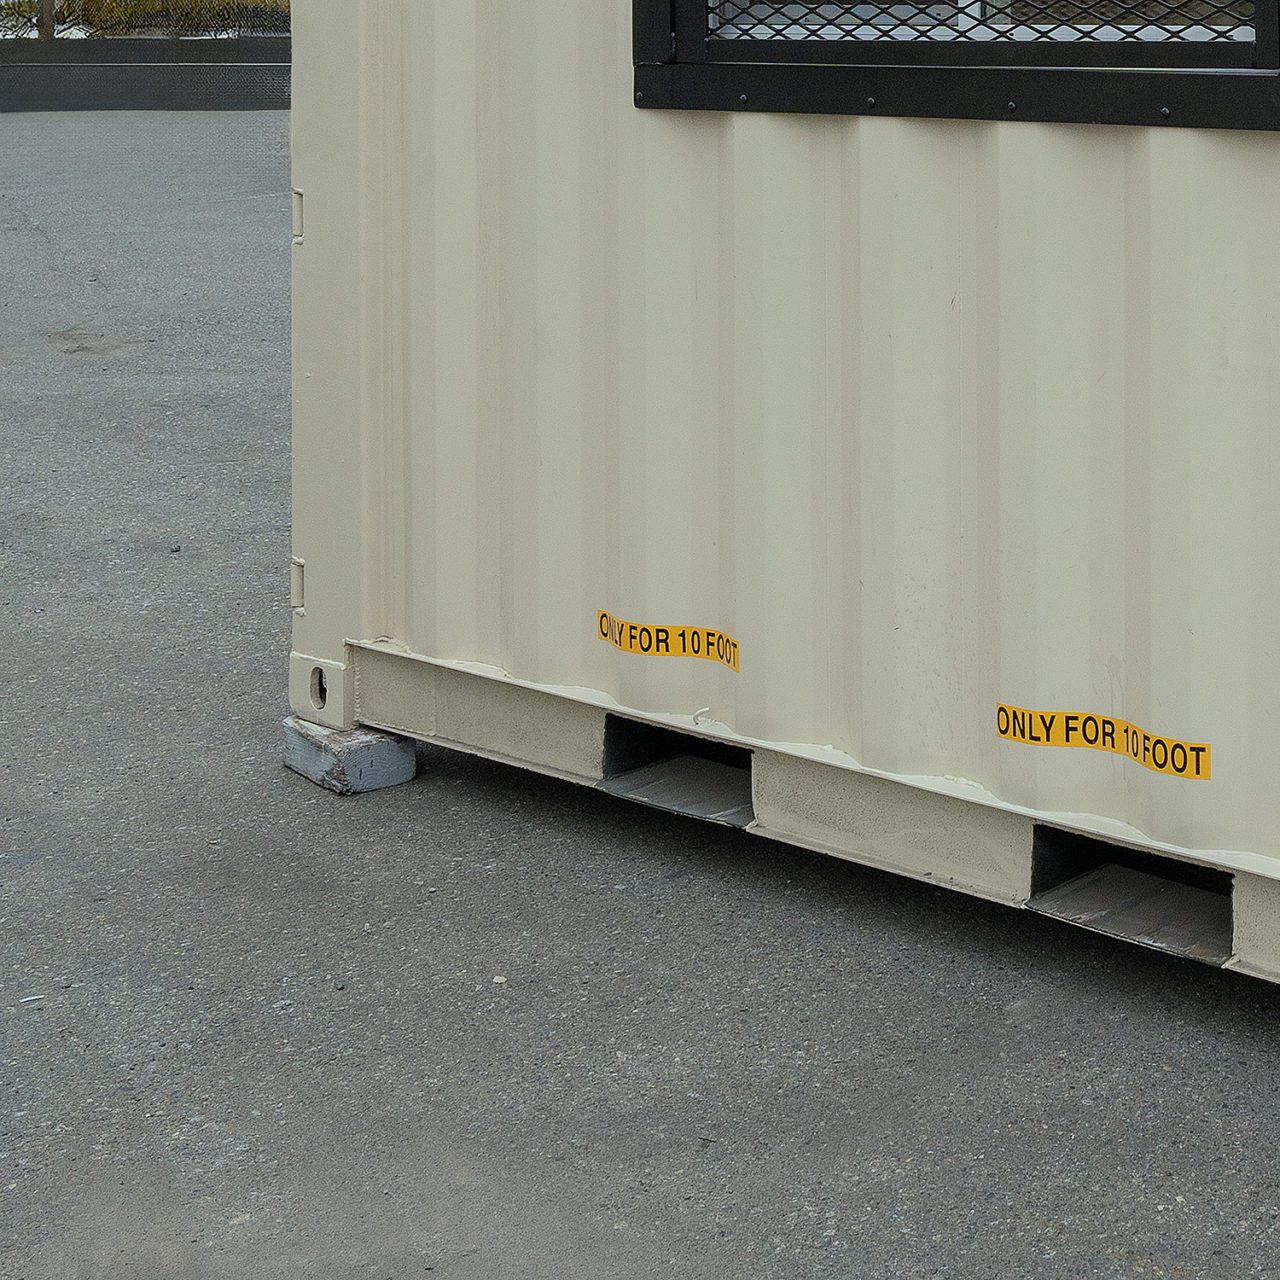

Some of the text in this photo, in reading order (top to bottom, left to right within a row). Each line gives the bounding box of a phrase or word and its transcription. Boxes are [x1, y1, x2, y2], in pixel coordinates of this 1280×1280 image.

[600, 613, 738, 668] ONLY FOR 10 FOOT
[997, 706, 1206, 776] ONLY FOR 10 FOOT
